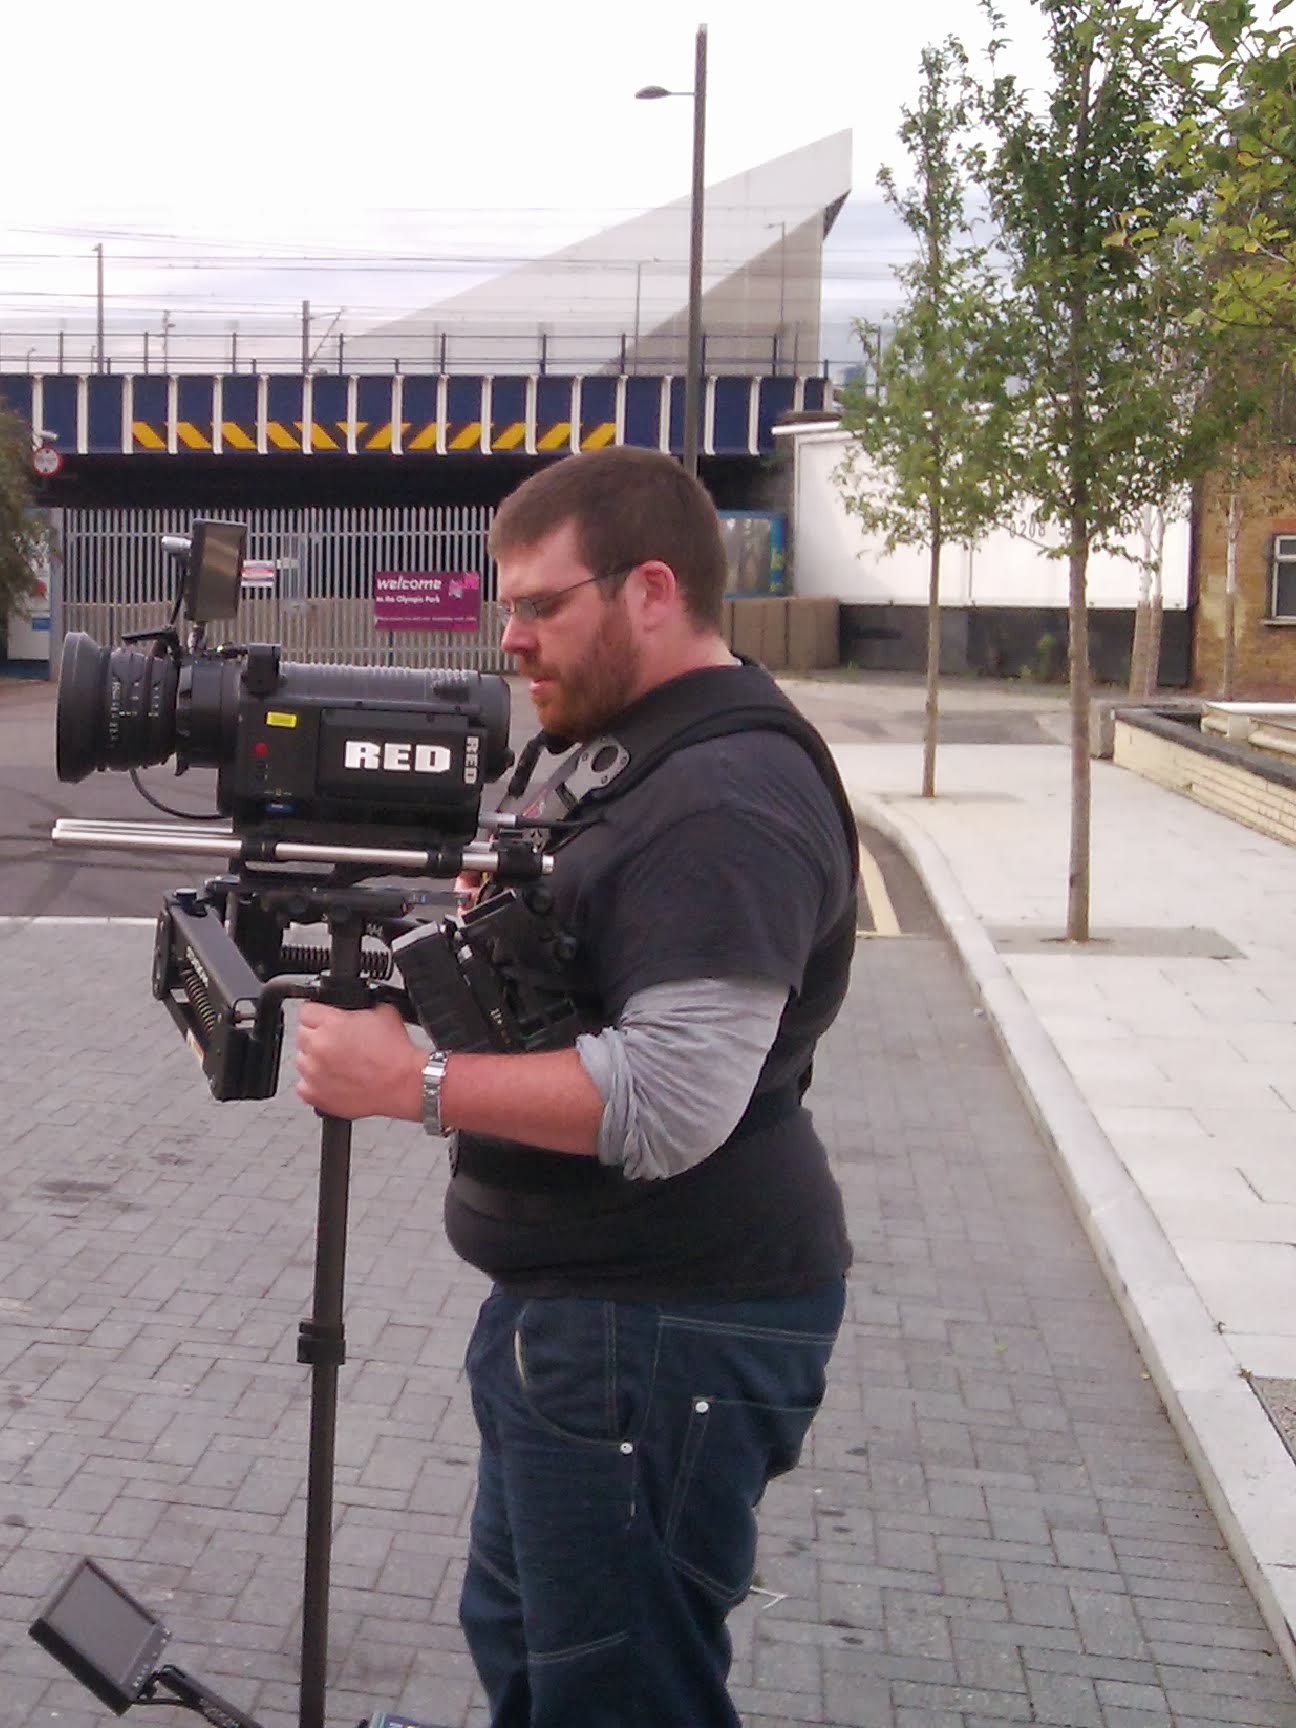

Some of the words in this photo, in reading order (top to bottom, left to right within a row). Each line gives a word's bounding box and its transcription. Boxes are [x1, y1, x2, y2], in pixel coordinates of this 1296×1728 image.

[376, 575, 442, 590] welcome
[396, 595, 424, 605] Olympic
[425, 595, 440, 603] Park
[345, 741, 451, 773] RED
[465, 735, 479, 784] RED
